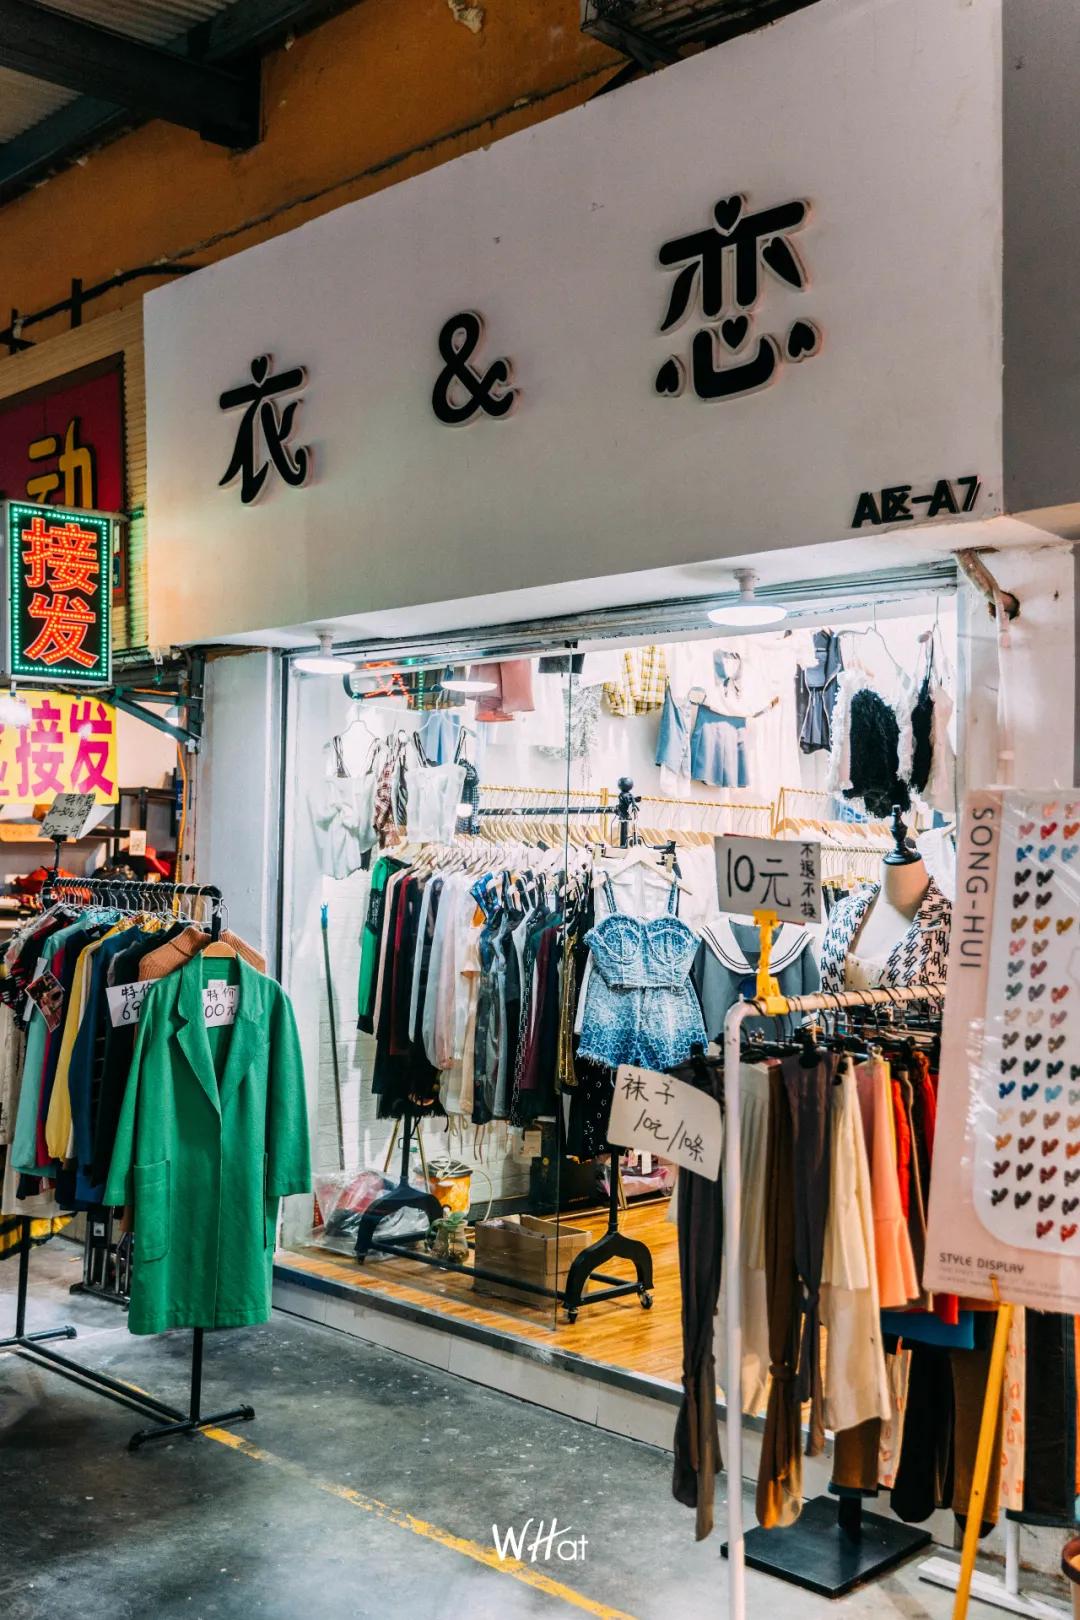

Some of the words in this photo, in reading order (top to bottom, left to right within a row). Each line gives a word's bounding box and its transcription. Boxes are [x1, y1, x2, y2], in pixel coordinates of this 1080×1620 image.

[218, 353, 309, 505] 衣
[431, 310, 521, 426] &
[655, 193, 822, 402] 恋
[21, 517, 99, 668] 接发
[0, 699, 114, 798] 接发
[727, 847, 792, 907] 10元
[959, 807, 995, 968] SONG-HUI
[620, 1072, 676, 1105] 袜子
[939, 1252, 973, 1267] STYLE
[976, 1257, 1025, 1274] DISPLAY
